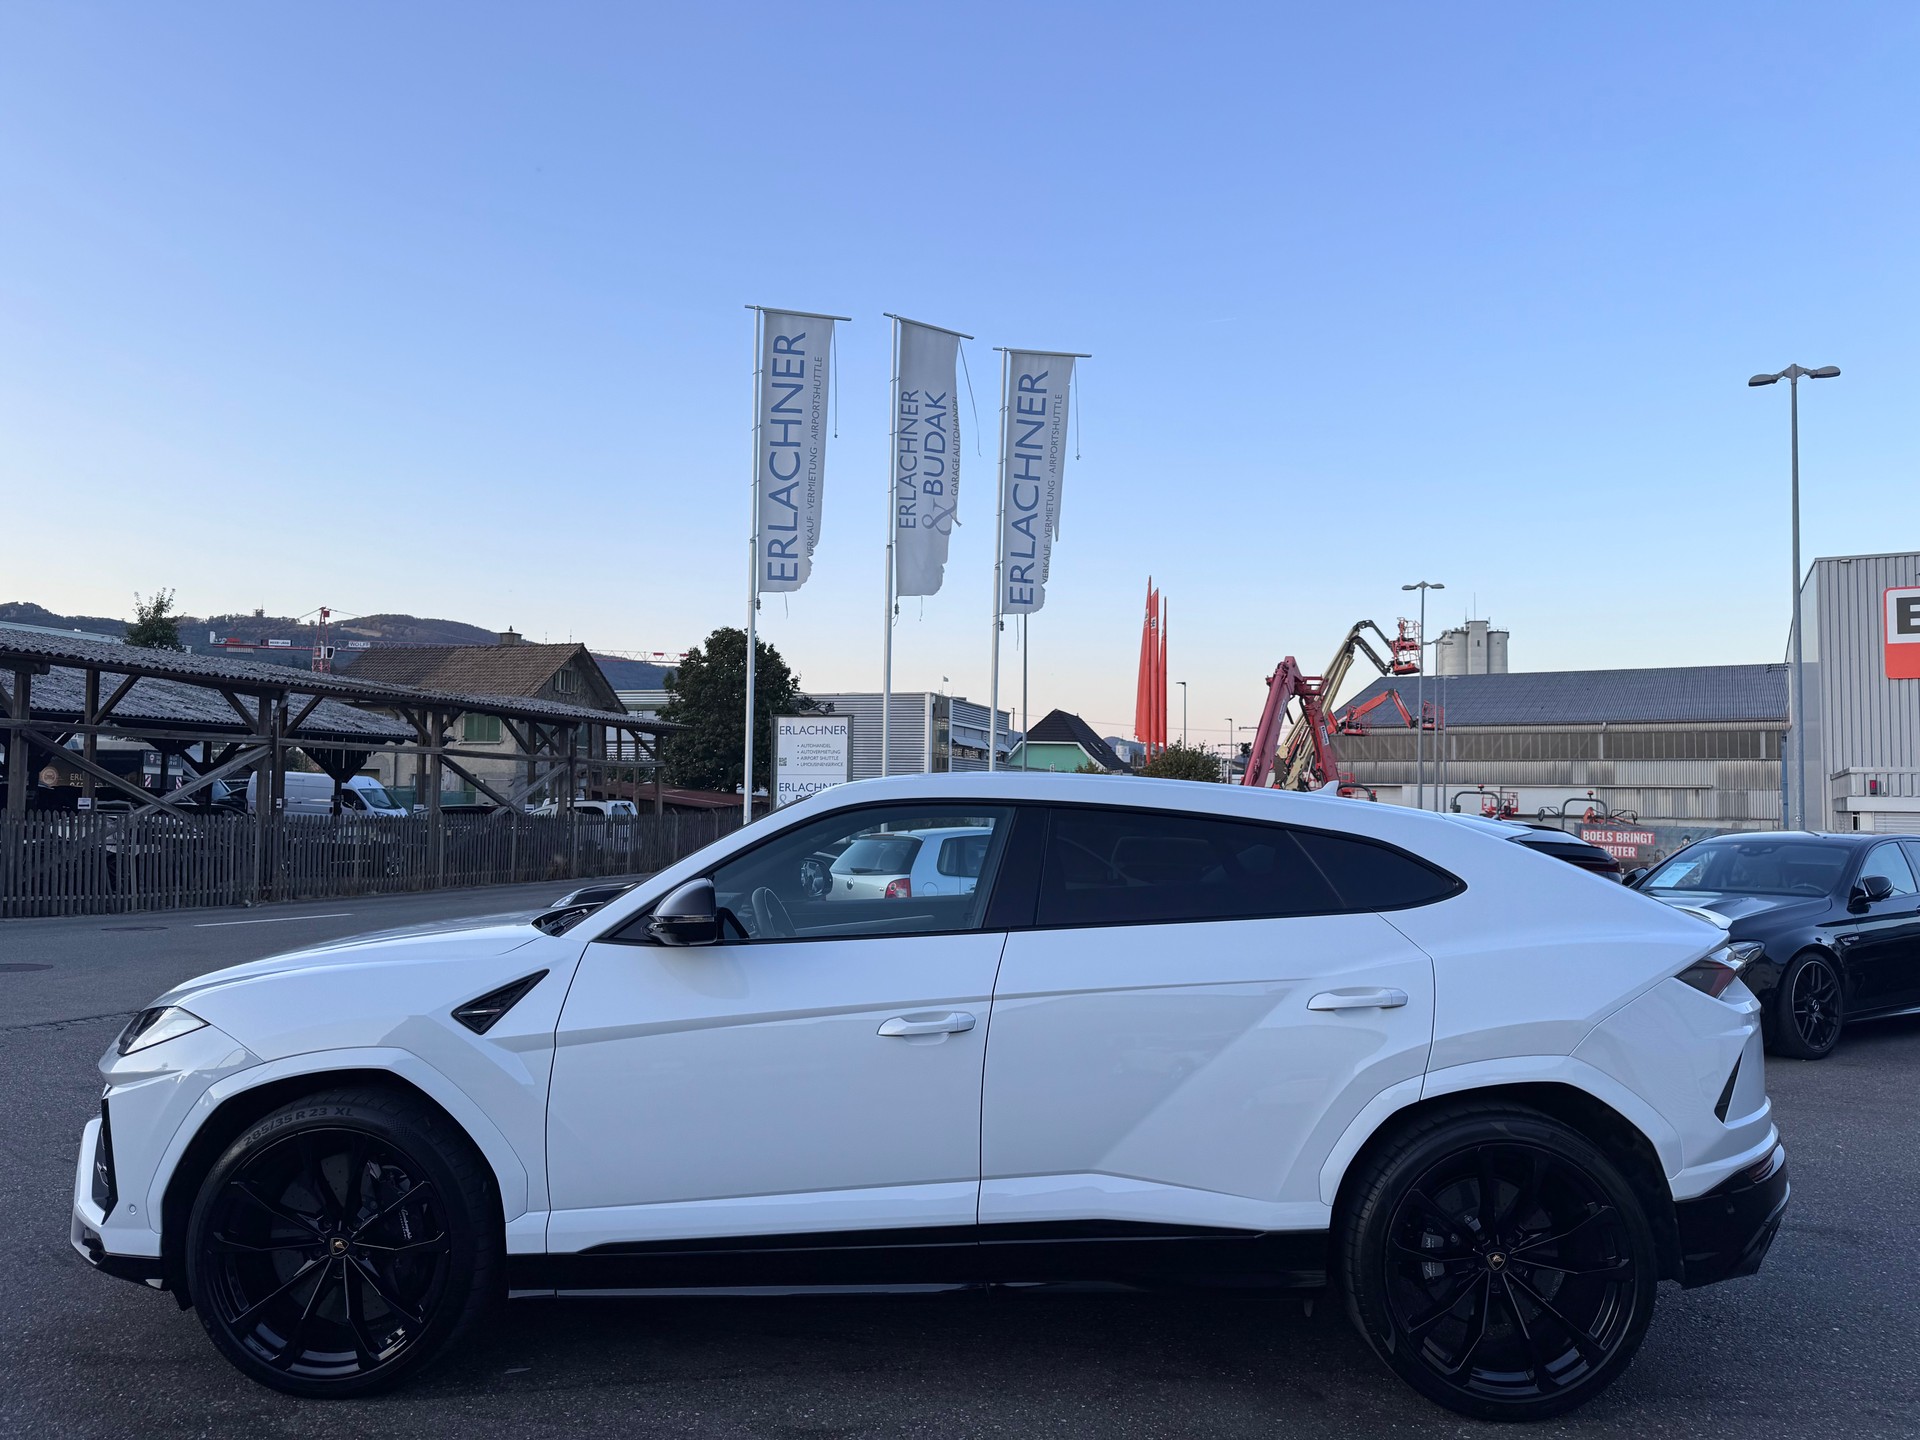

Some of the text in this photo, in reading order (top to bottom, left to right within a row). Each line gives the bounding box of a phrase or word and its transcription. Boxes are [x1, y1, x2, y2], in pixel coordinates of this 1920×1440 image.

[811, 356, 823, 440] AIRPORTSHUTTLE
[767, 332, 806, 581] ERLACHNER
[898, 389, 919, 529] ERLACHNER
[922, 390, 947, 496] BUDAK
[1048, 394, 1063, 474] AIRPORTSHUTTLE
[807, 446, 819, 510] VERMIETUNG
[950, 458, 960, 496] GARAGE
[1009, 370, 1048, 605] ERLACHNER
[1044, 479, 1056, 539] VERMIETUNG
[779, 726, 847, 735] ERLACHNER
[779, 782, 843, 792] ERLACHN
[1583, 831, 1653, 844] BOELS BRINGT
[243, 1115, 293, 1146] 285/35
[334, 1106, 355, 1118] XL
